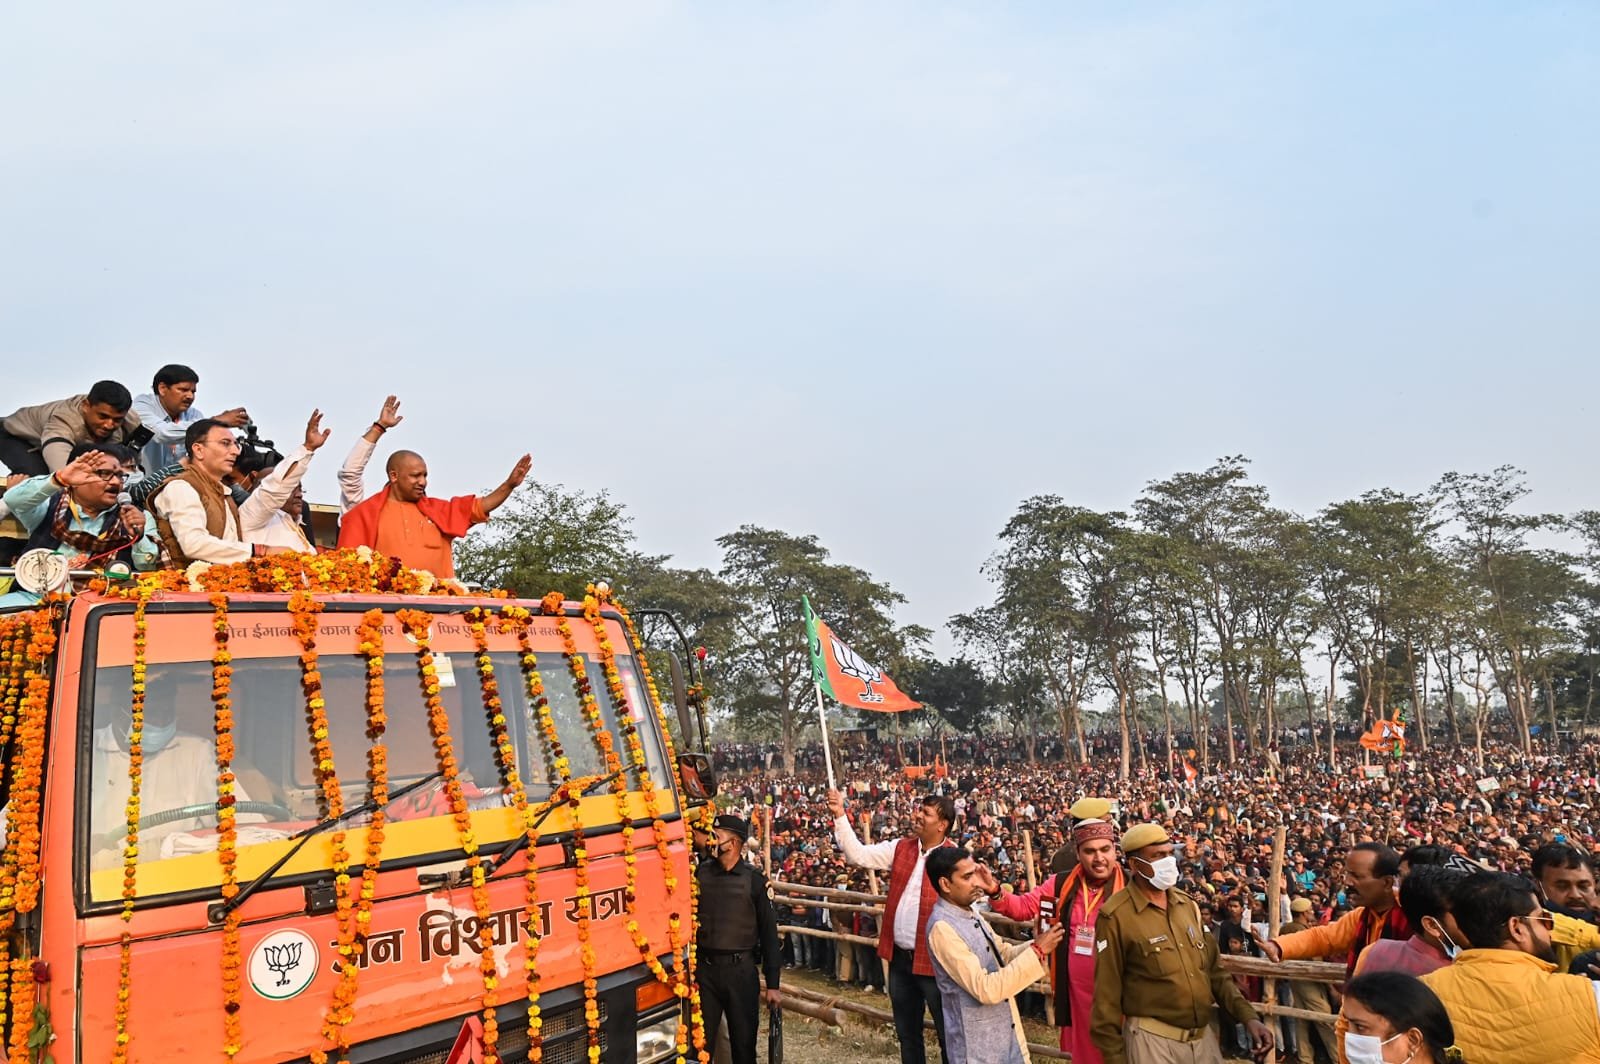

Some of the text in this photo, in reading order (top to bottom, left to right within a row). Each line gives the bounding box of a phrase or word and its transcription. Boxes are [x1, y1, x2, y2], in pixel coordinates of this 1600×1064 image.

[320, 625, 351, 636] काम
[437, 621, 461, 635] फिर
[418, 901, 553, 962] विश्वास
[564, 886, 628, 923] यात्रा
